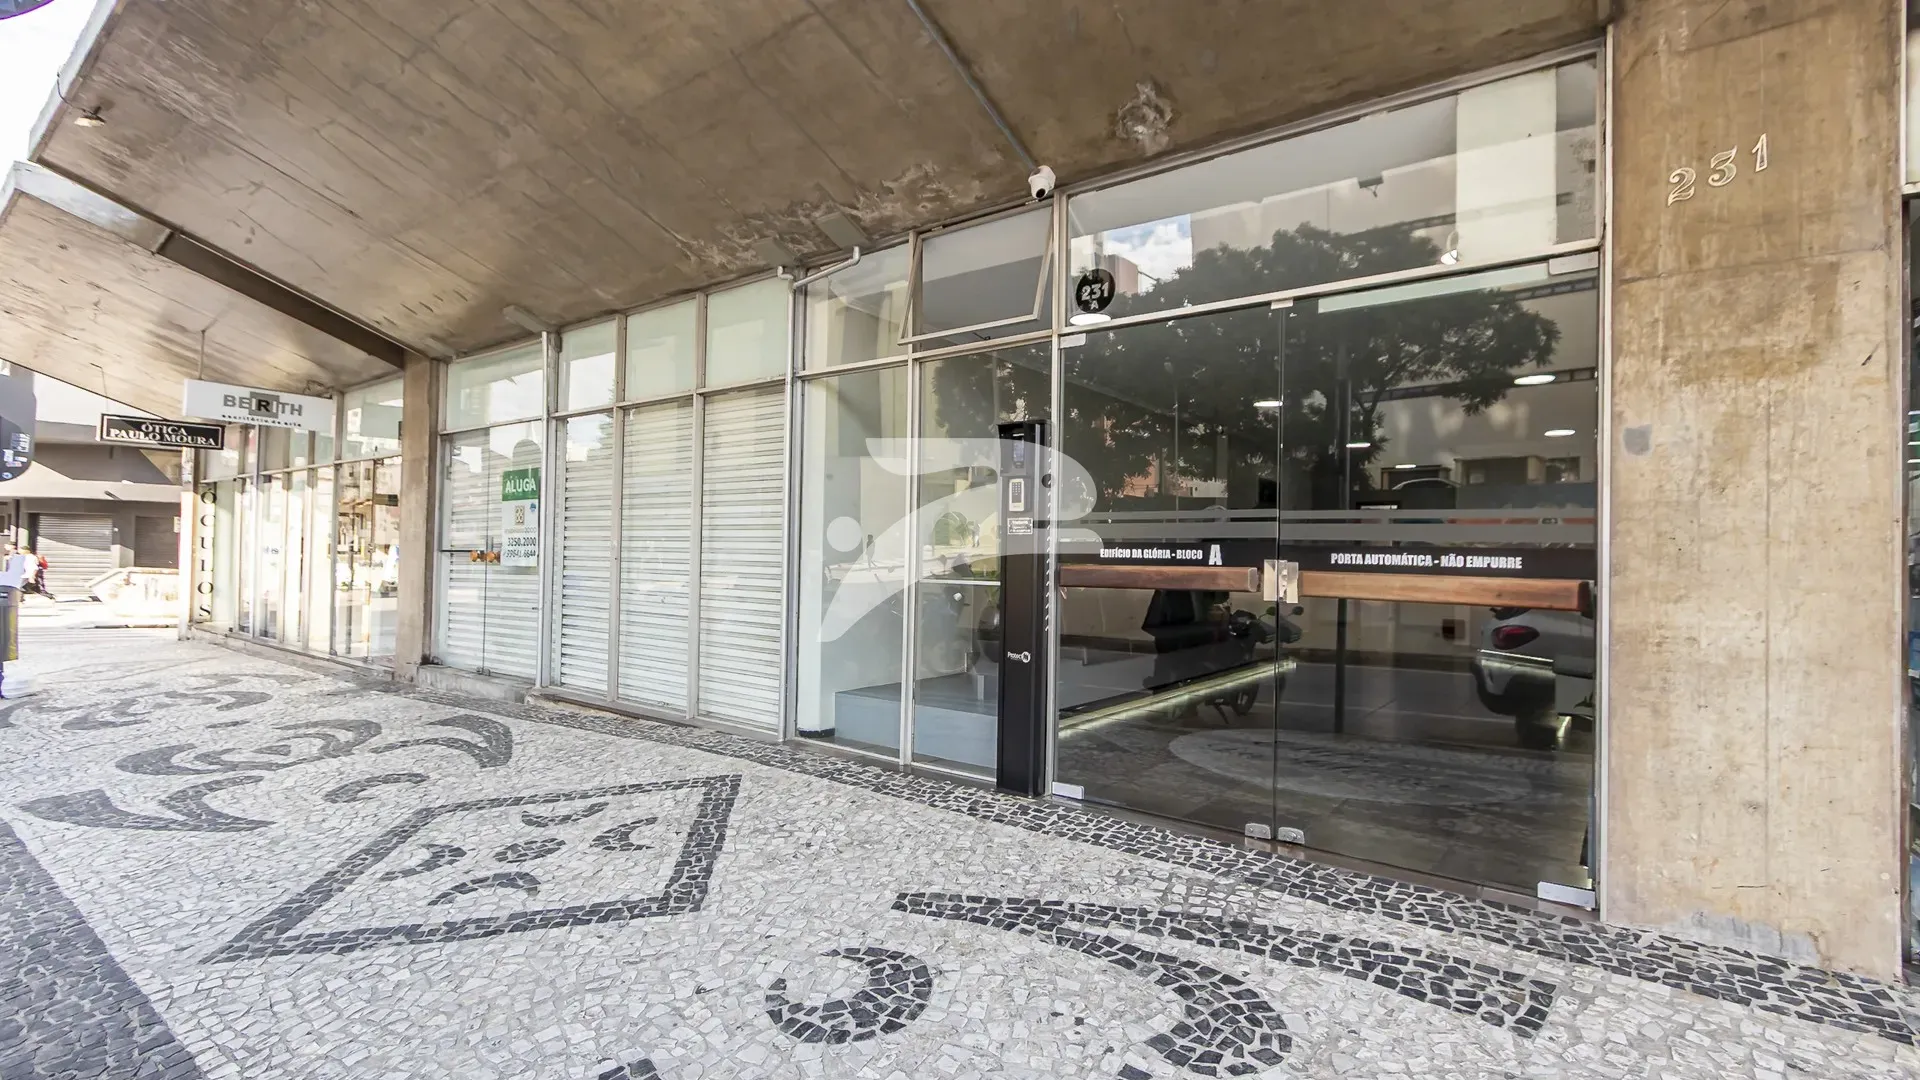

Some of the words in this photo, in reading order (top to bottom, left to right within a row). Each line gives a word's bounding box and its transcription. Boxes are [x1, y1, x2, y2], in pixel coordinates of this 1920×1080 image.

[1666, 132, 1769, 207] 231
[1081, 281, 1109, 300] 231
[1090, 300, 1099, 310] A
[109, 428, 160, 441] PAULO
[163, 433, 216, 446] MOURA
[141, 421, 188, 436] ÓTICA
[505, 477, 537, 493] ALUGA
[198, 488, 217, 617] ÓCULOS
[1100, 546, 1131, 558] EDIFÍCIO
[1132, 549, 1143, 558] DA
[1143, 547, 1171, 559] GLÓRIA
[1176, 549, 1203, 559] BLOCO
[1208, 544, 1223, 566] A
[1330, 553, 1363, 565] PORTA
[1364, 552, 1433, 567] AUTOMÁTICA
[1440, 553, 1464, 568] NÃO
[1466, 556, 1522, 569] EMPURRE
